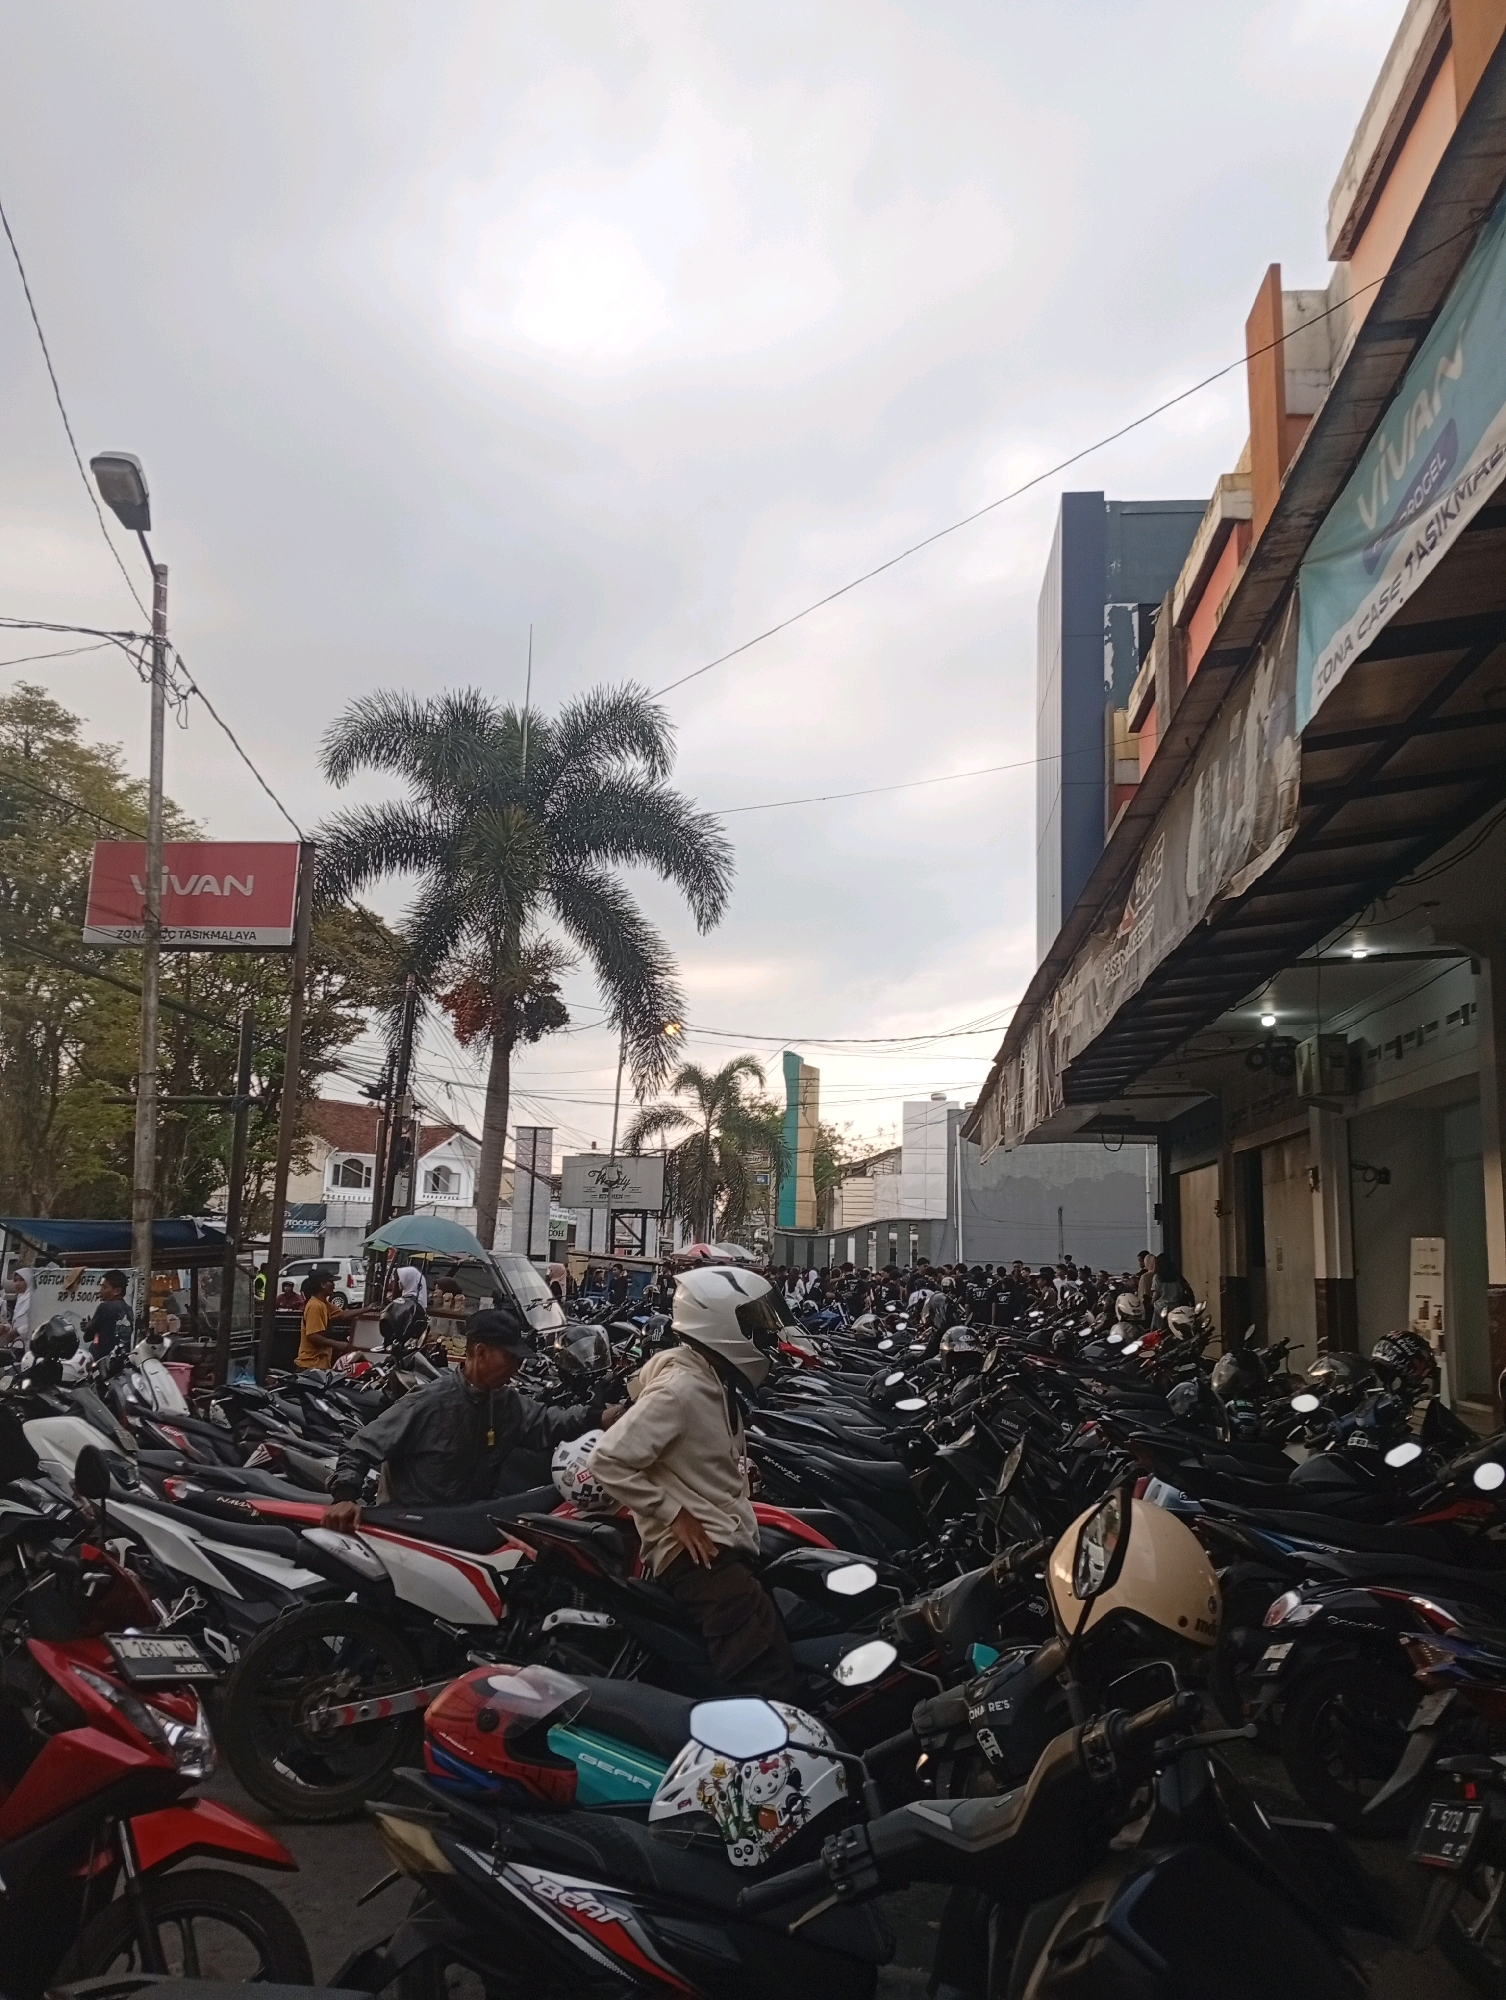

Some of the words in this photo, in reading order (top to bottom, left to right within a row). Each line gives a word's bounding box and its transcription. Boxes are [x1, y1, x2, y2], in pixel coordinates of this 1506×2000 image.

[1317, 633, 1354, 696] ZONA
[1357, 571, 1402, 641] CASE
[179, 930, 257, 941] TASIKMALAYA
[284, 1219, 321, 1227] UTOCARE
[57, 1291, 69, 1302] RP
[578, 1752, 652, 1790] GEAR
